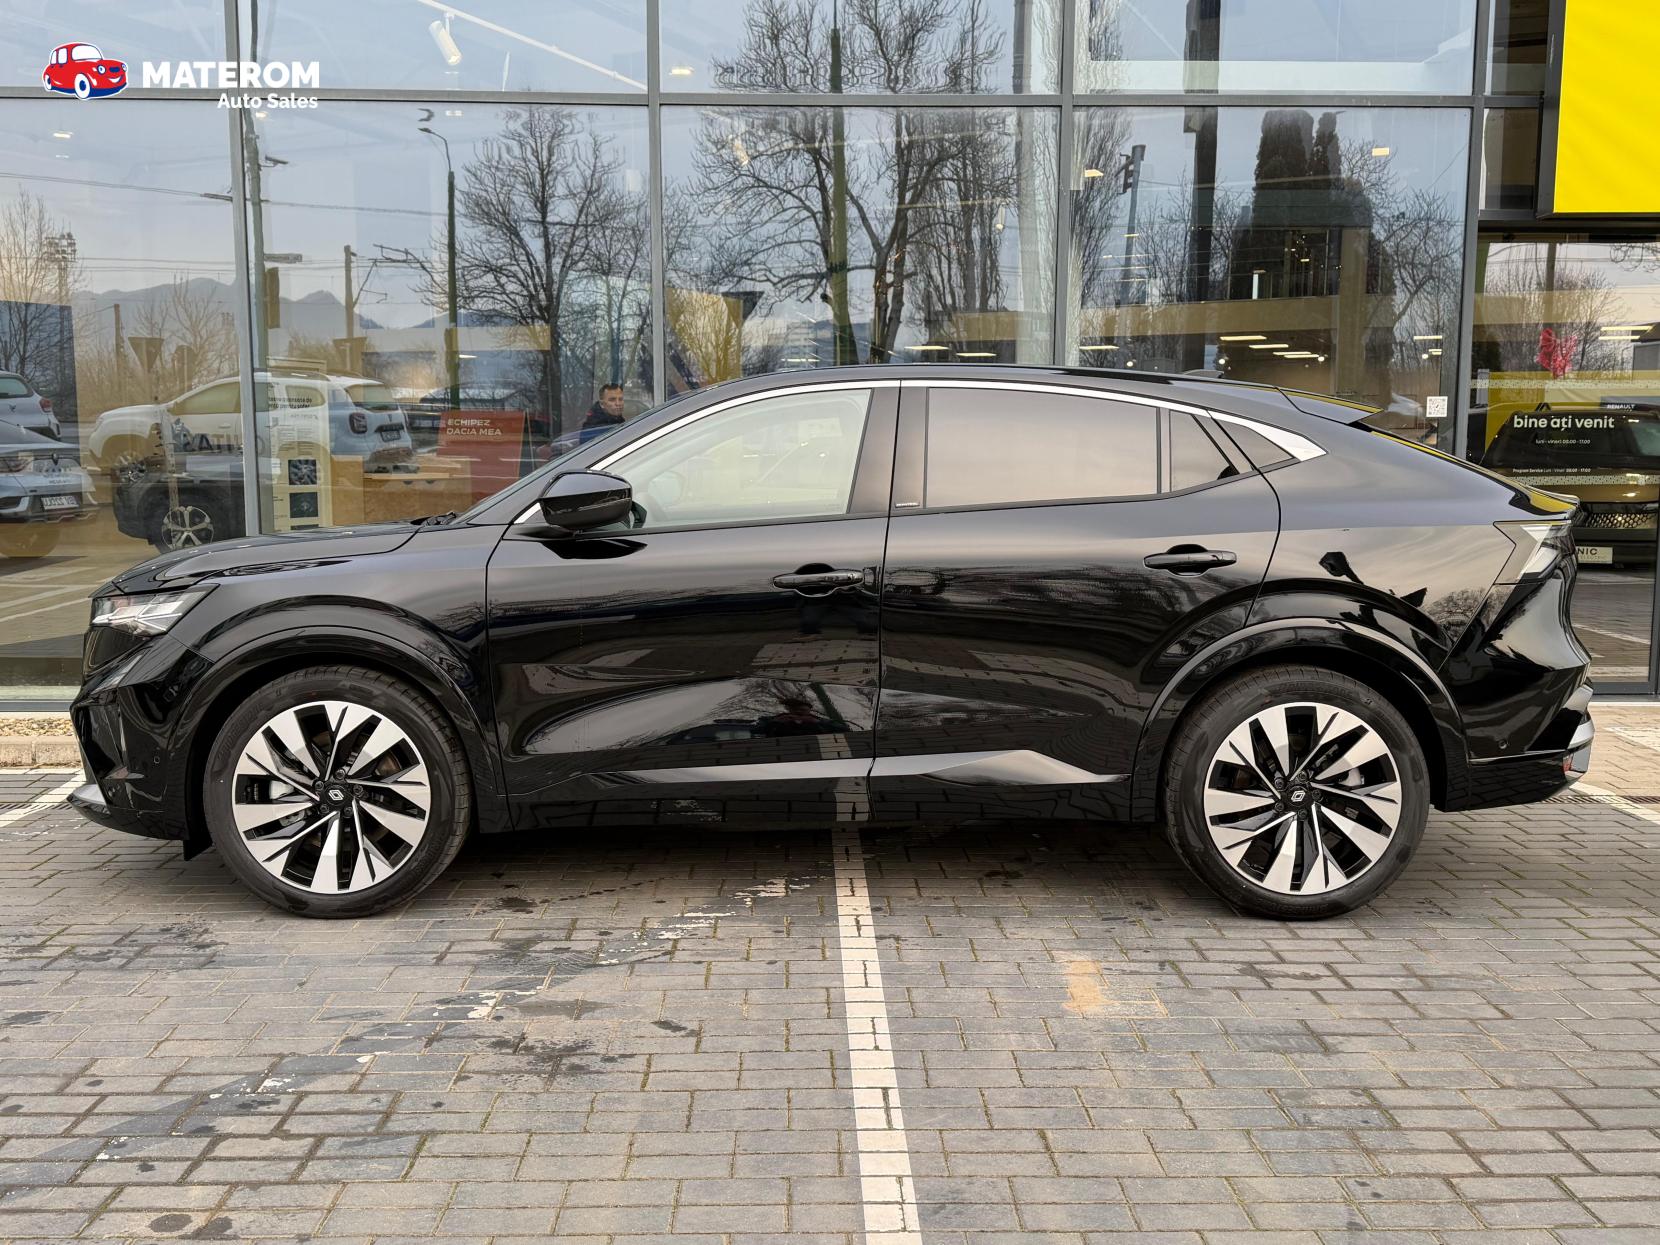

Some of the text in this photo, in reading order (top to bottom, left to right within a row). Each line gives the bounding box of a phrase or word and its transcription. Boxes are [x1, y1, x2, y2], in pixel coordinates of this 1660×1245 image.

[447, 418, 491, 426] ECHIPEZ
[1513, 415, 1615, 432] bine ați venit
[446, 427, 502, 436] DACIA MEA
